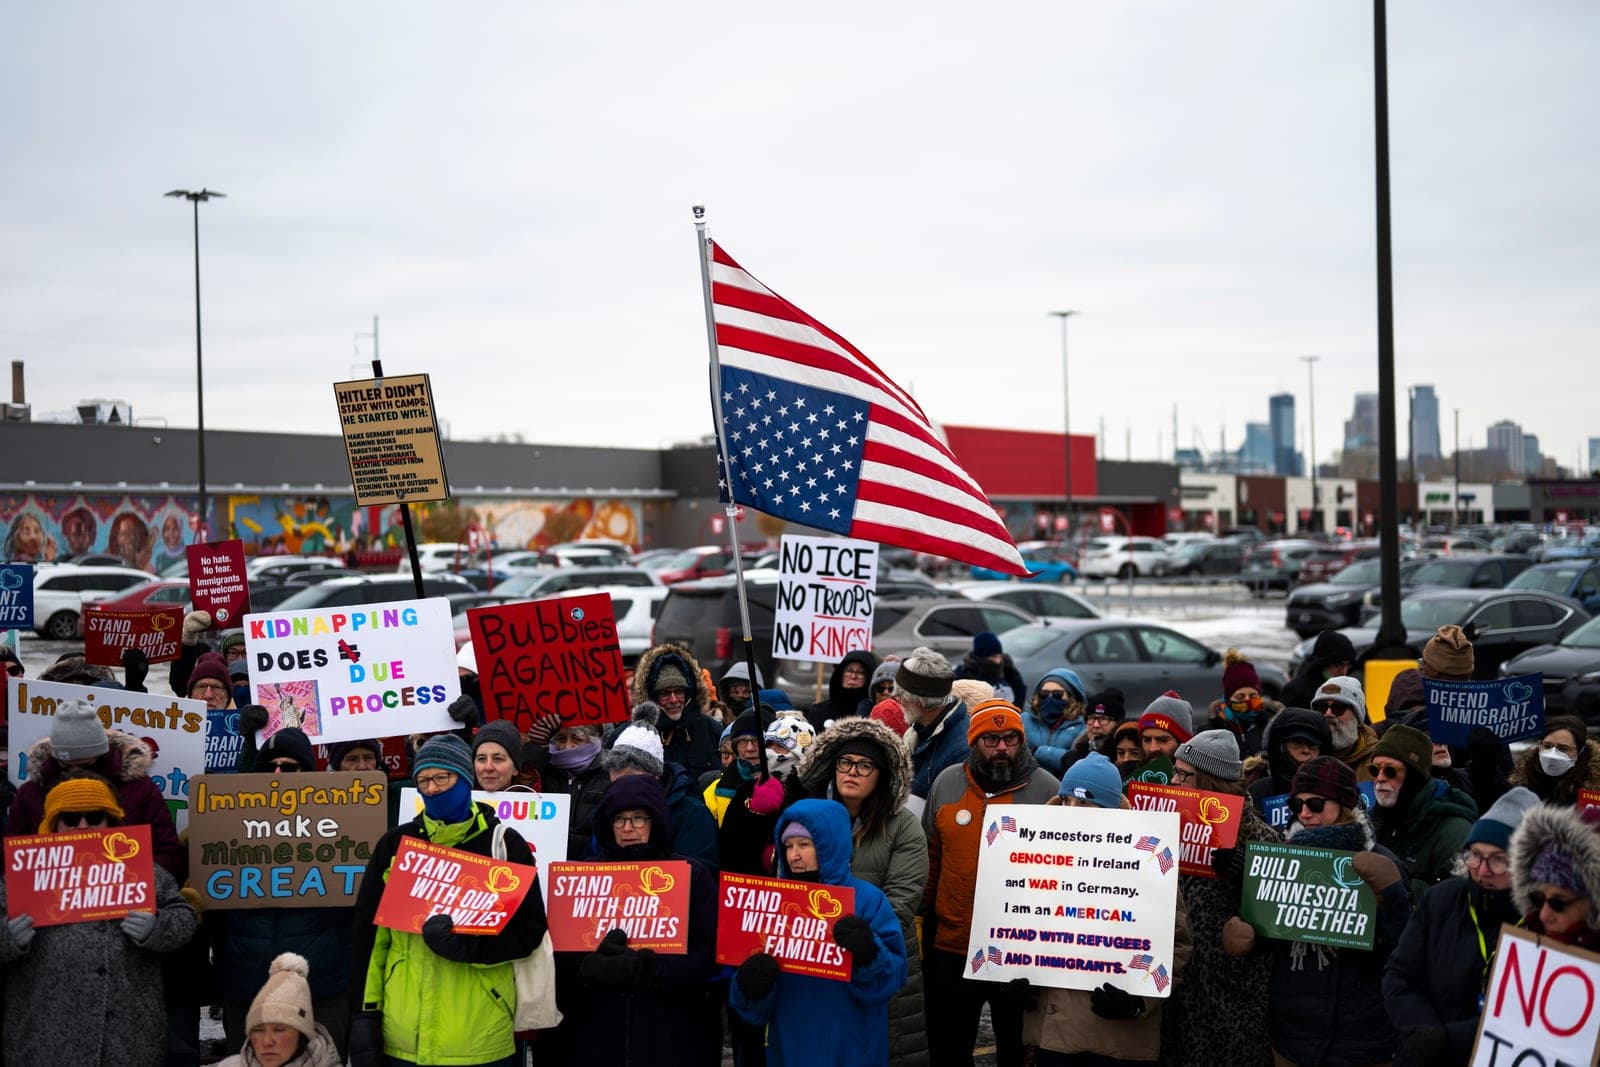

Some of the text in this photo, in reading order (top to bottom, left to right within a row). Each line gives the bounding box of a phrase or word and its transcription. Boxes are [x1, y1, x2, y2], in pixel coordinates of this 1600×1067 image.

[339, 384, 424, 403] HITLER DIDN'T
[341, 398, 428, 414] START WITH CAMPS.
[343, 409, 428, 424] HE STARTED WITH:
[352, 451, 416, 462] BLAMING IMMIGRANTS
[359, 490, 394, 498] DEMONIZING
[201, 555, 232, 565] No hate.
[203, 565, 232, 575] No fear.
[782, 541, 873, 579] NO ICE
[197, 574, 240, 586] Immigrants
[210, 584, 243, 594] welcome
[211, 594, 230, 605] here!
[778, 580, 875, 617] NO TROOPS
[89, 618, 131, 633] STAND
[251, 608, 417, 639] KIDNAPPING
[479, 603, 614, 655] Bubbies
[103, 632, 165, 646] WITH OUR
[775, 622, 804, 654] NO
[120, 642, 177, 659] FILIES
[257, 649, 328, 672] DOES
[350, 661, 405, 683] DUE
[490, 644, 620, 690] AGAINST
[18, 683, 202, 733] Imgrants
[331, 685, 446, 716] PROCESS
[494, 679, 631, 729] FASCISM
[1431, 689, 1488, 708] DEFEND
[1441, 701, 1530, 725] IMMIGRANT
[1485, 715, 1537, 737] IGHTS
[197, 778, 384, 816] Immigrants
[1164, 788, 1200, 798] IMMIGRANTS
[487, 800, 556, 820] OULD
[55, 833, 101, 842] IMMIGRANTS
[243, 815, 339, 839] make
[1019, 828, 1132, 844] My ancestors fled
[1182, 822, 1213, 845] OUR
[12, 845, 74, 871] STAND
[404, 839, 491, 866] STAND WITH IMMIGRANTS
[1009, 852, 1140, 870] GENOCIDE in Ireland
[1289, 848, 1333, 858] IMMIGRANTS
[34, 862, 125, 891] WITH OUR
[399, 851, 461, 883] STAND
[1249, 856, 1300, 880] BUILD
[206, 865, 366, 900] GREAT
[410, 877, 498, 911] WITH OUR
[554, 876, 612, 896] STAND
[724, 875, 808, 891] STAND WITH IMMIGRANTS
[1005, 878, 1139, 898] and WAR in Germany.
[60, 882, 147, 911] FAMILIES
[572, 896, 659, 918] WITH OUR
[724, 886, 782, 912] STAND
[1256, 880, 1359, 911] MINNESOTA
[1004, 902, 1136, 923] I am an AMERICAN.
[1275, 904, 1368, 936] TOGETHER
[742, 911, 828, 940] WITH OUR
[990, 927, 1151, 951] I STAND WITH REFUGEES
[765, 936, 846, 966] FAMILIES
[1004, 952, 1127, 974] AND IMMIGRANTS.
[1493, 942, 1595, 1037] NO
